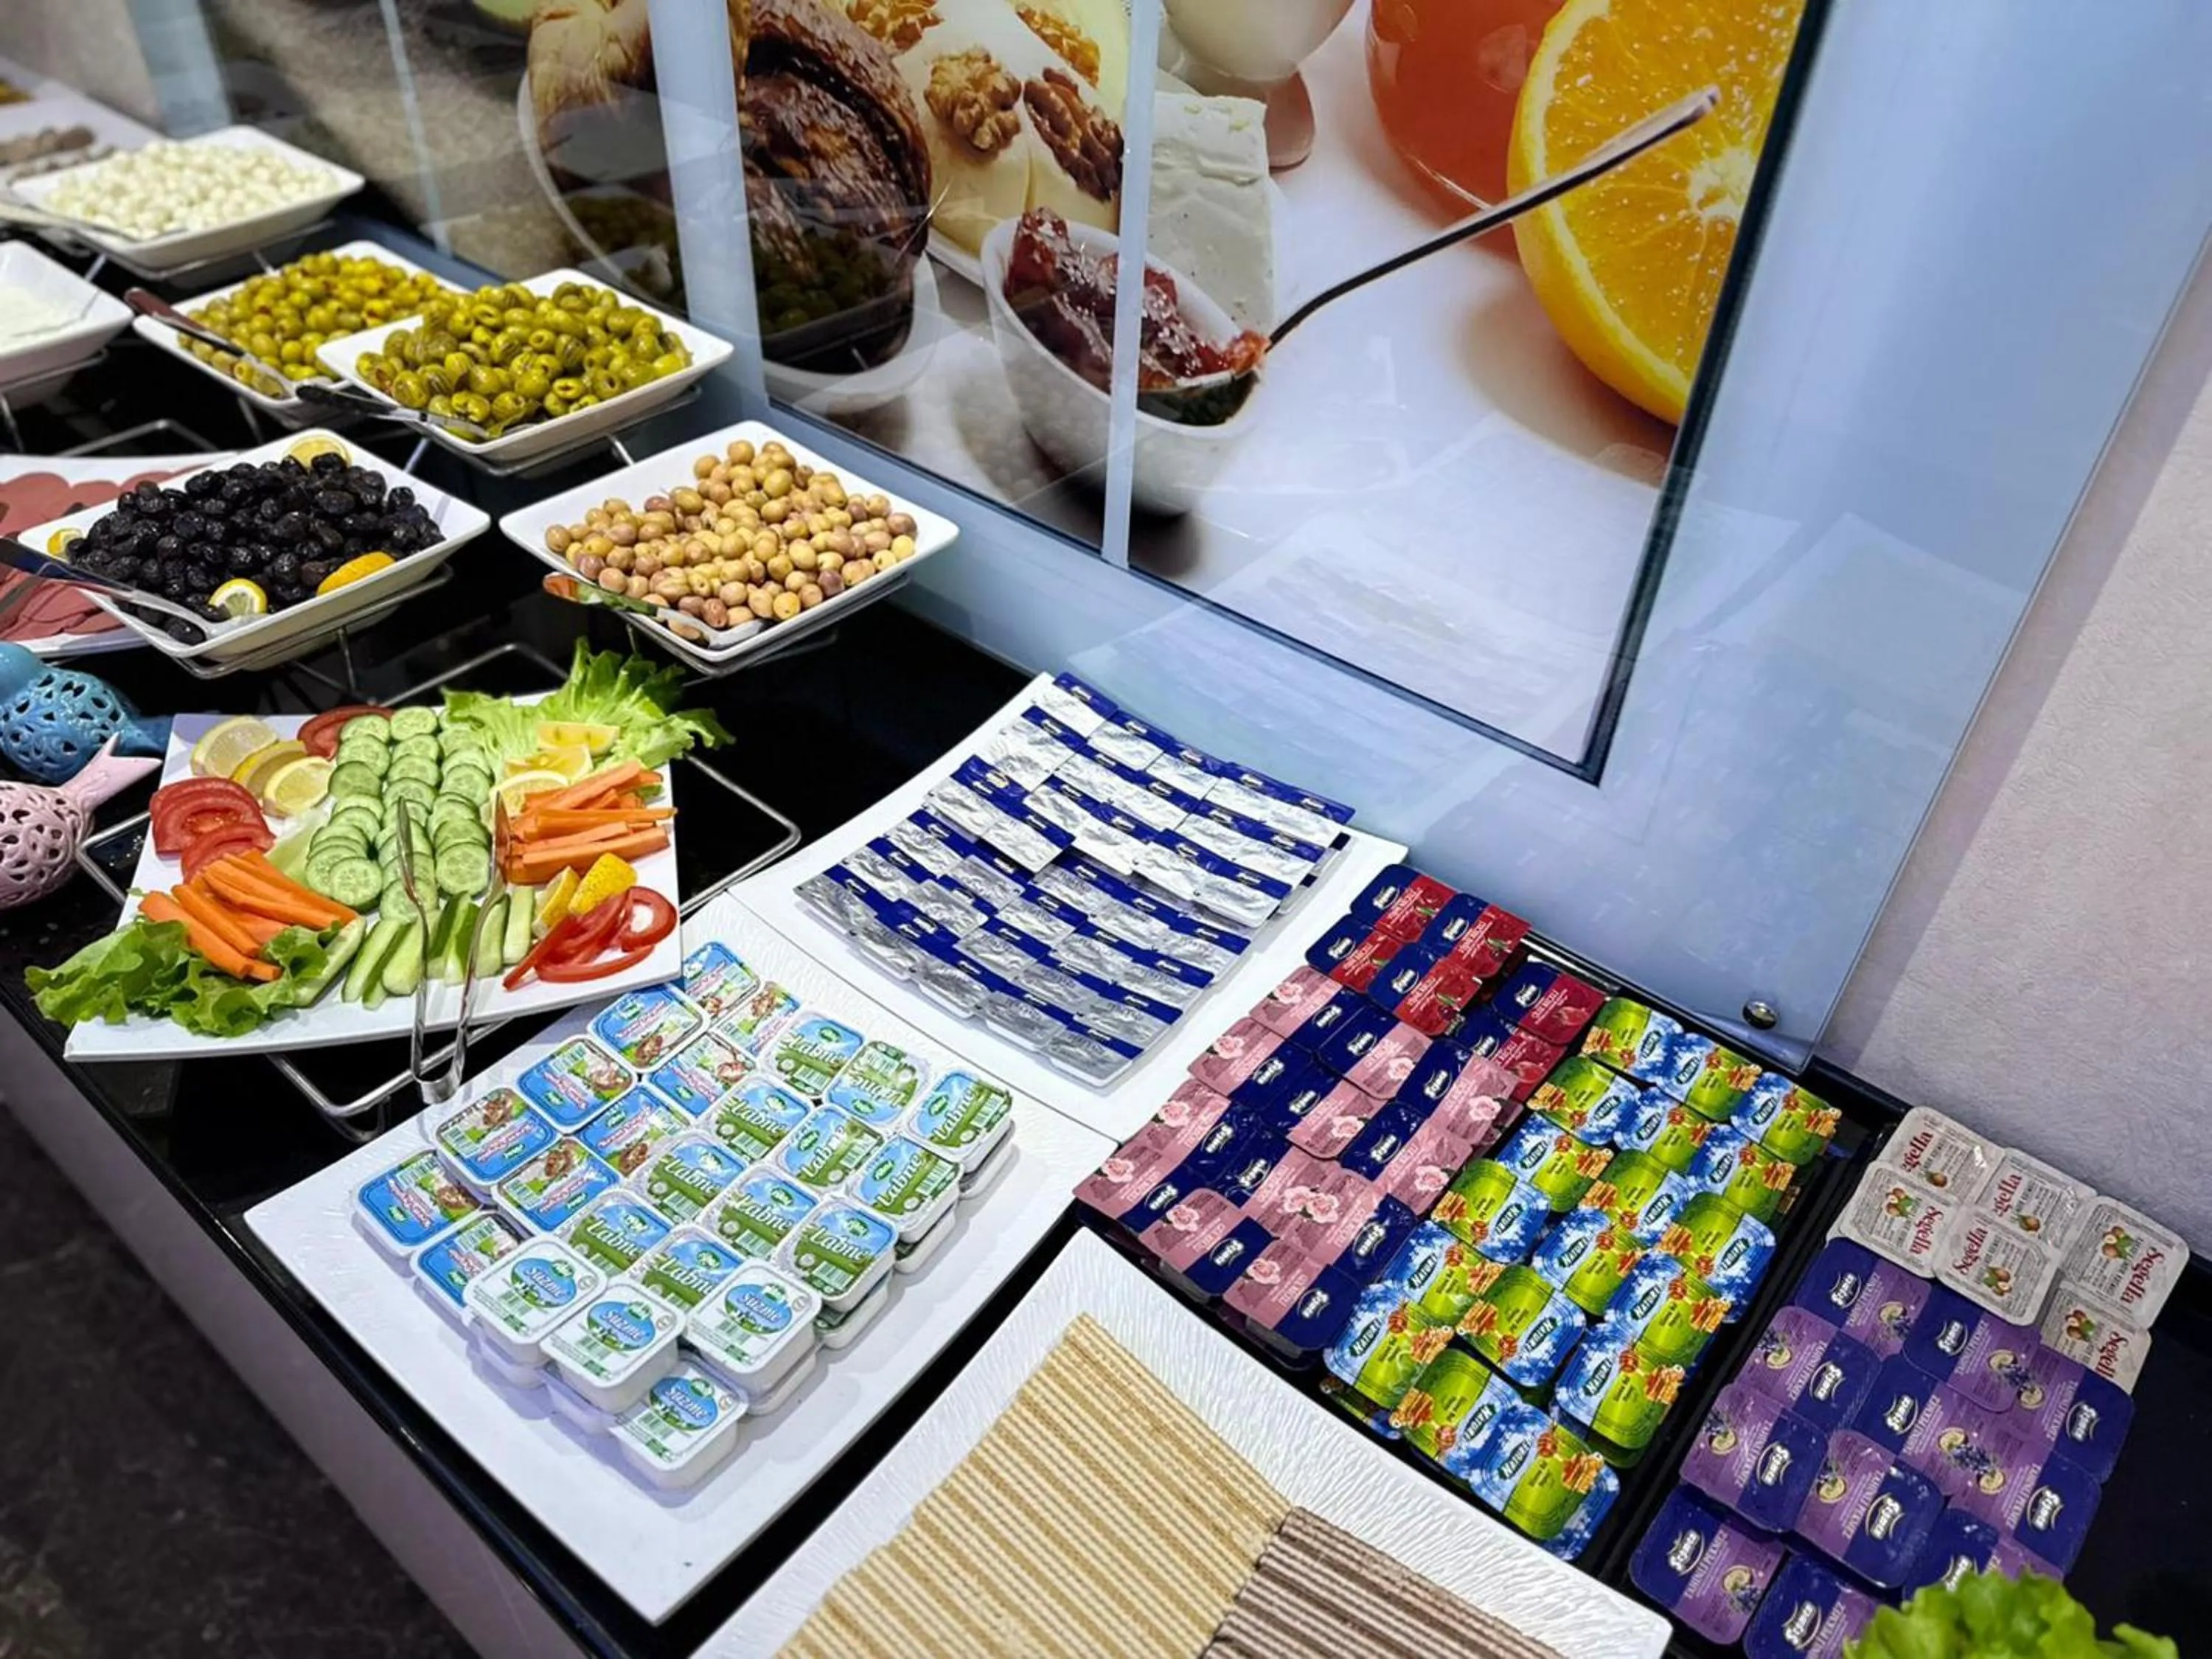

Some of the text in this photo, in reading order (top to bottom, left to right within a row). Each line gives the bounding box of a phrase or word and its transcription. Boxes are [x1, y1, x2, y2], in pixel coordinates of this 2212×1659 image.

[792, 1032, 845, 1064] Labne
[849, 1074, 905, 1107] Labne
[735, 1099, 787, 1135] Labne
[934, 1089, 975, 1141] Labne
[800, 1125, 846, 1178] Labne
[665, 1157, 719, 1196] Labne
[877, 1153, 923, 1206] Labne
[737, 1195, 793, 1237] Labne
[1907, 1206, 1944, 1255] Segella
[588, 1220, 644, 1257] Labne
[810, 1229, 869, 1260] Labne
[1952, 1225, 1989, 1275] Segella
[2119, 1246, 2166, 1305] Segella
[2095, 1331, 2129, 1378] Segell
